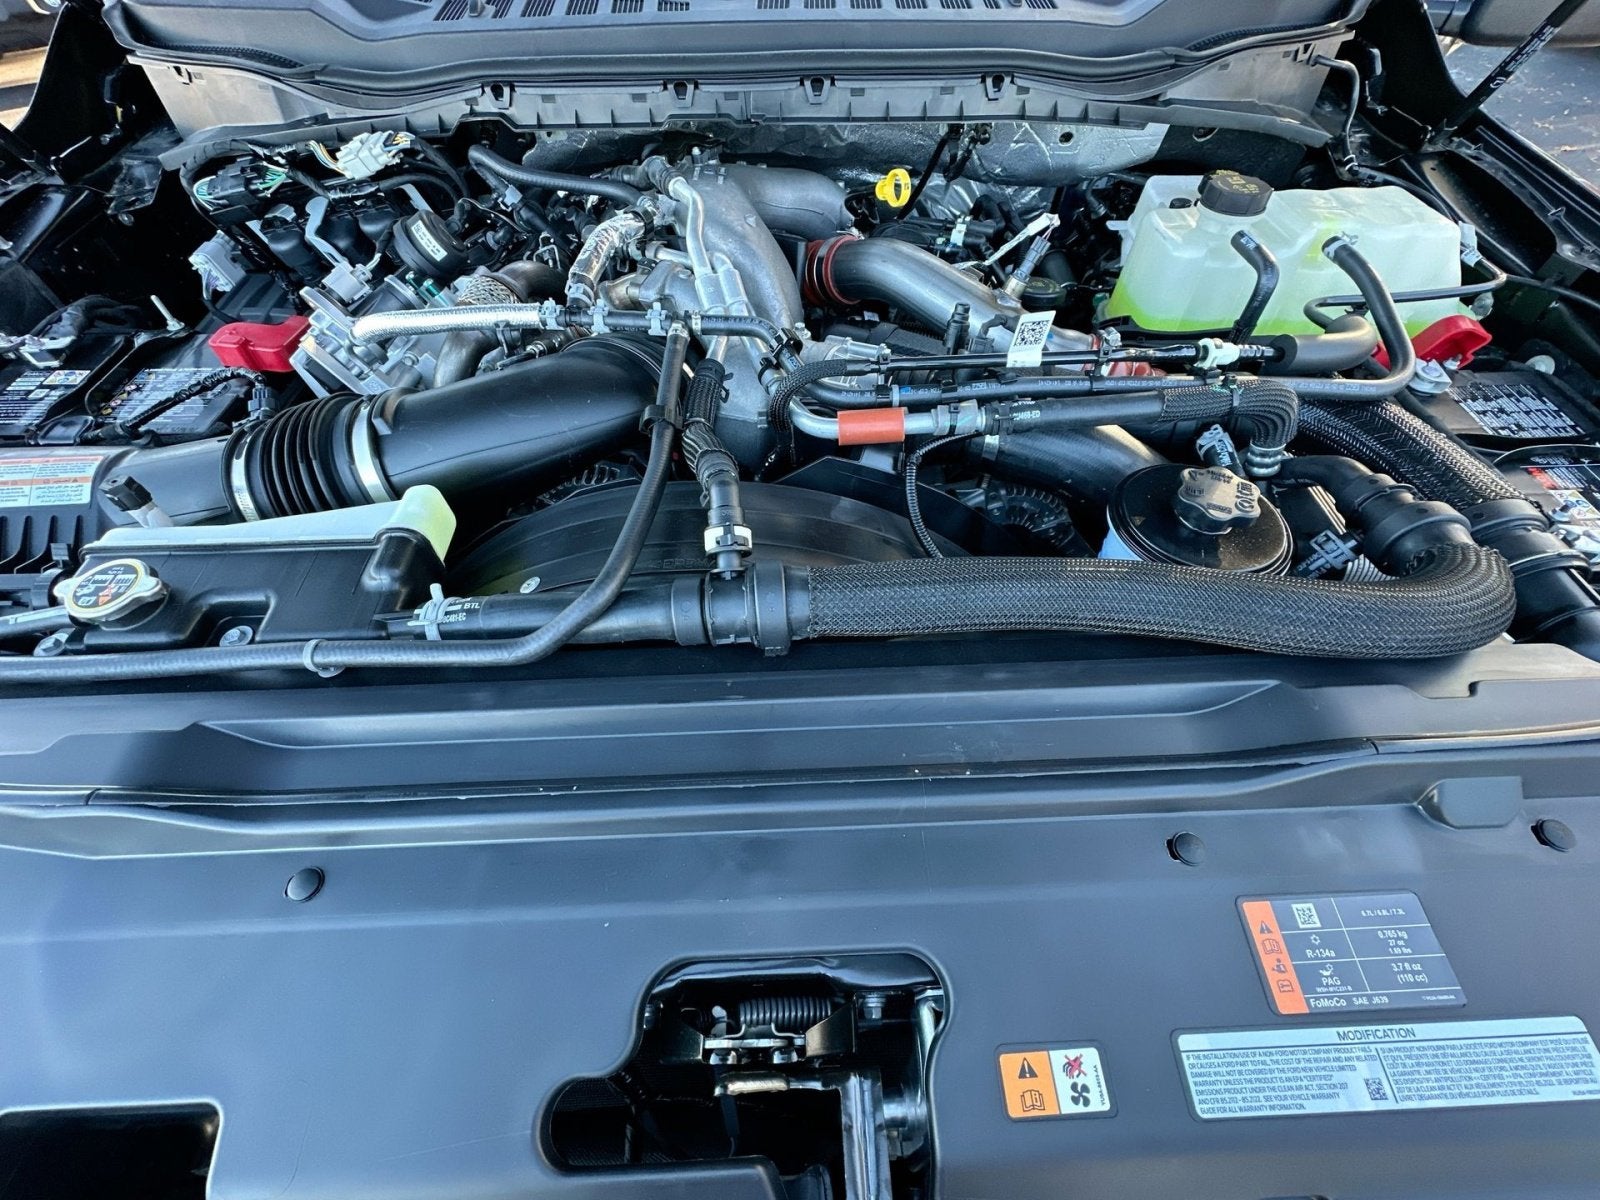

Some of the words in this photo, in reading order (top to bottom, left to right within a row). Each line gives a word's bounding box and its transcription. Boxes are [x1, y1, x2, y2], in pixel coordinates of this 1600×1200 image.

[1397, 930, 1408, 940] kg
[1306, 948, 1336, 958] R-134a
[1391, 962, 1403, 972] 3.7
[1404, 962, 1412, 970] fl
[1322, 976, 1341, 986] PAG
[1397, 974, 1414, 984] (110
[1415, 973, 1428, 983] cc)
[1310, 996, 1346, 1008] FoMoCo
[1352, 996, 1369, 1005] SAE
[1372, 996, 1389, 1004] J639
[1336, 1028, 1416, 1042] MODIFICATION
